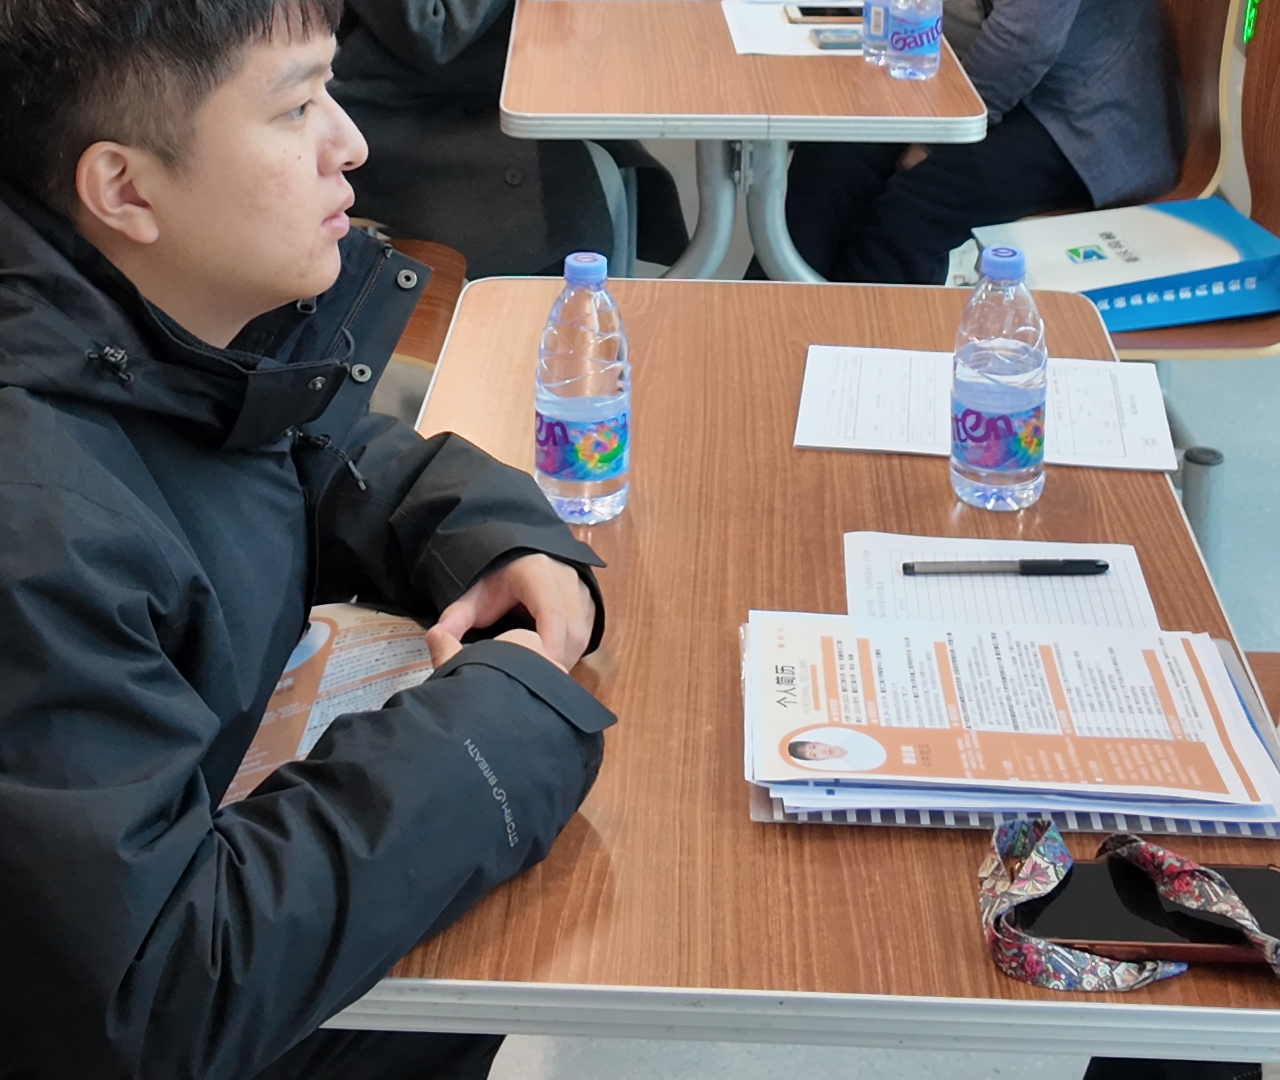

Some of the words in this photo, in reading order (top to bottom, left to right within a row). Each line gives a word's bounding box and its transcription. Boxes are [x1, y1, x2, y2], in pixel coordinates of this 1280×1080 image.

[774, 664, 798, 708] 个人简历
[463, 738, 499, 787] BREATH
[501, 802, 519, 848] STORM
